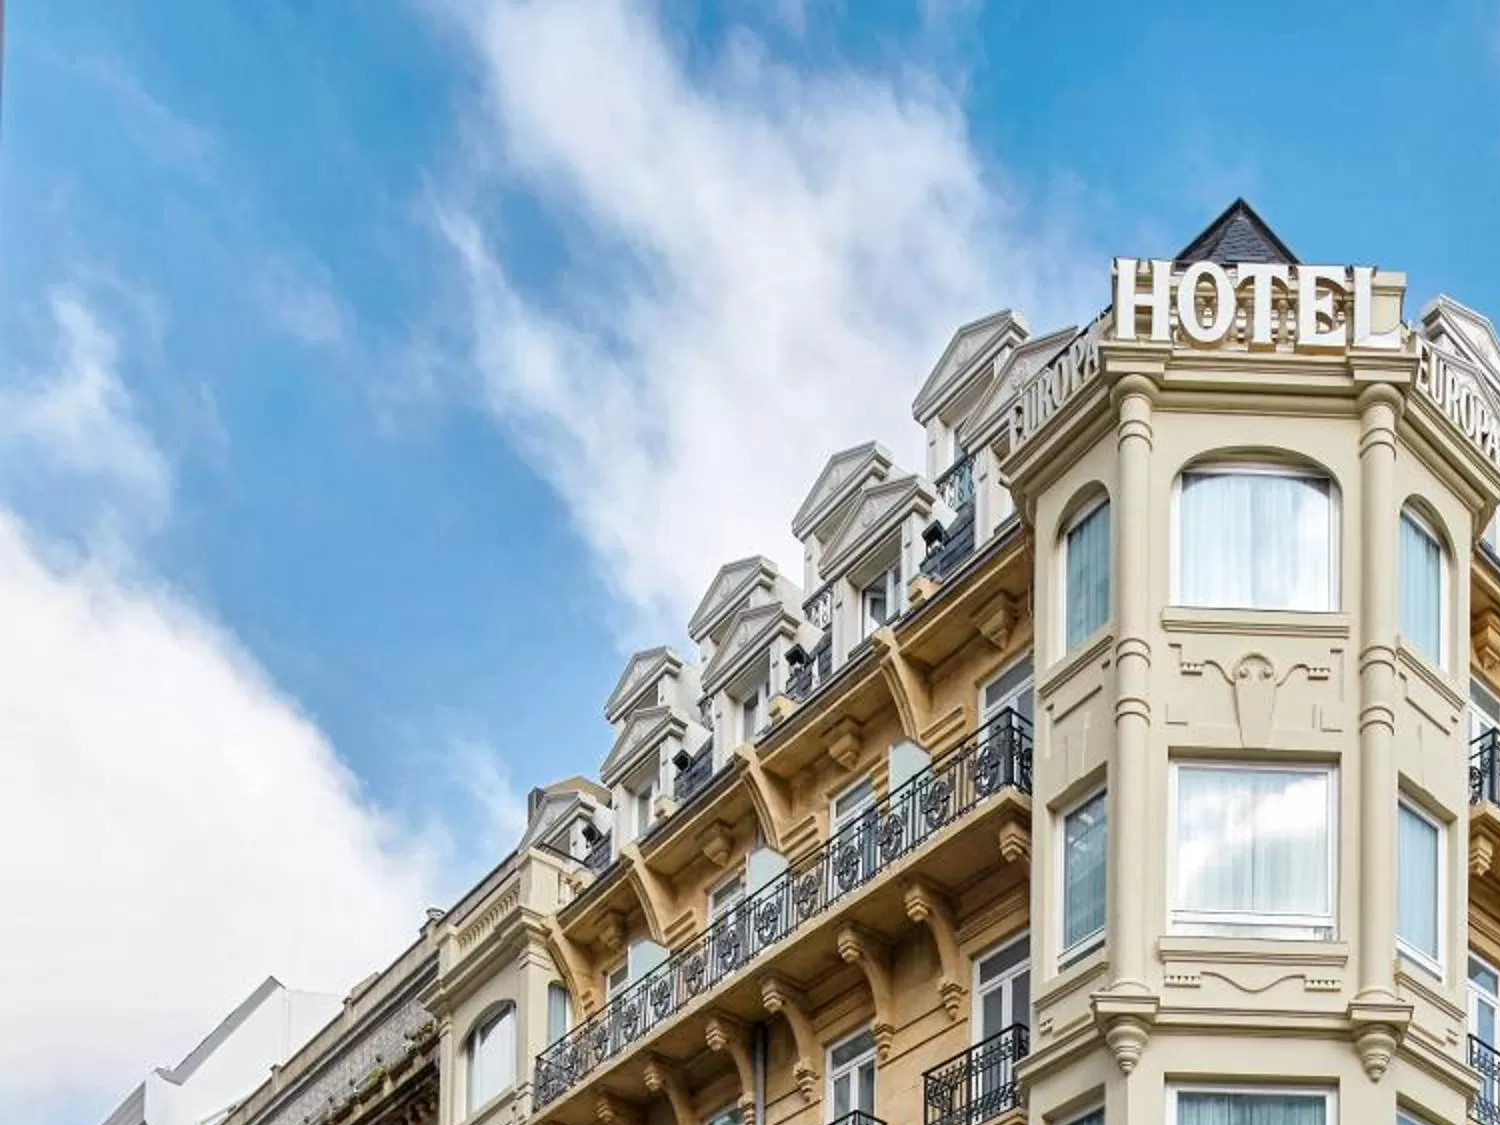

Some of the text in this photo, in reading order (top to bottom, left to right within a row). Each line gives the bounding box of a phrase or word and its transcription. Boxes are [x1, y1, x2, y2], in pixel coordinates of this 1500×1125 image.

[1114, 256, 1402, 349] HOTEL
[1009, 334, 1100, 450] EUROPA
[1415, 339, 1500, 470] EUROPA
